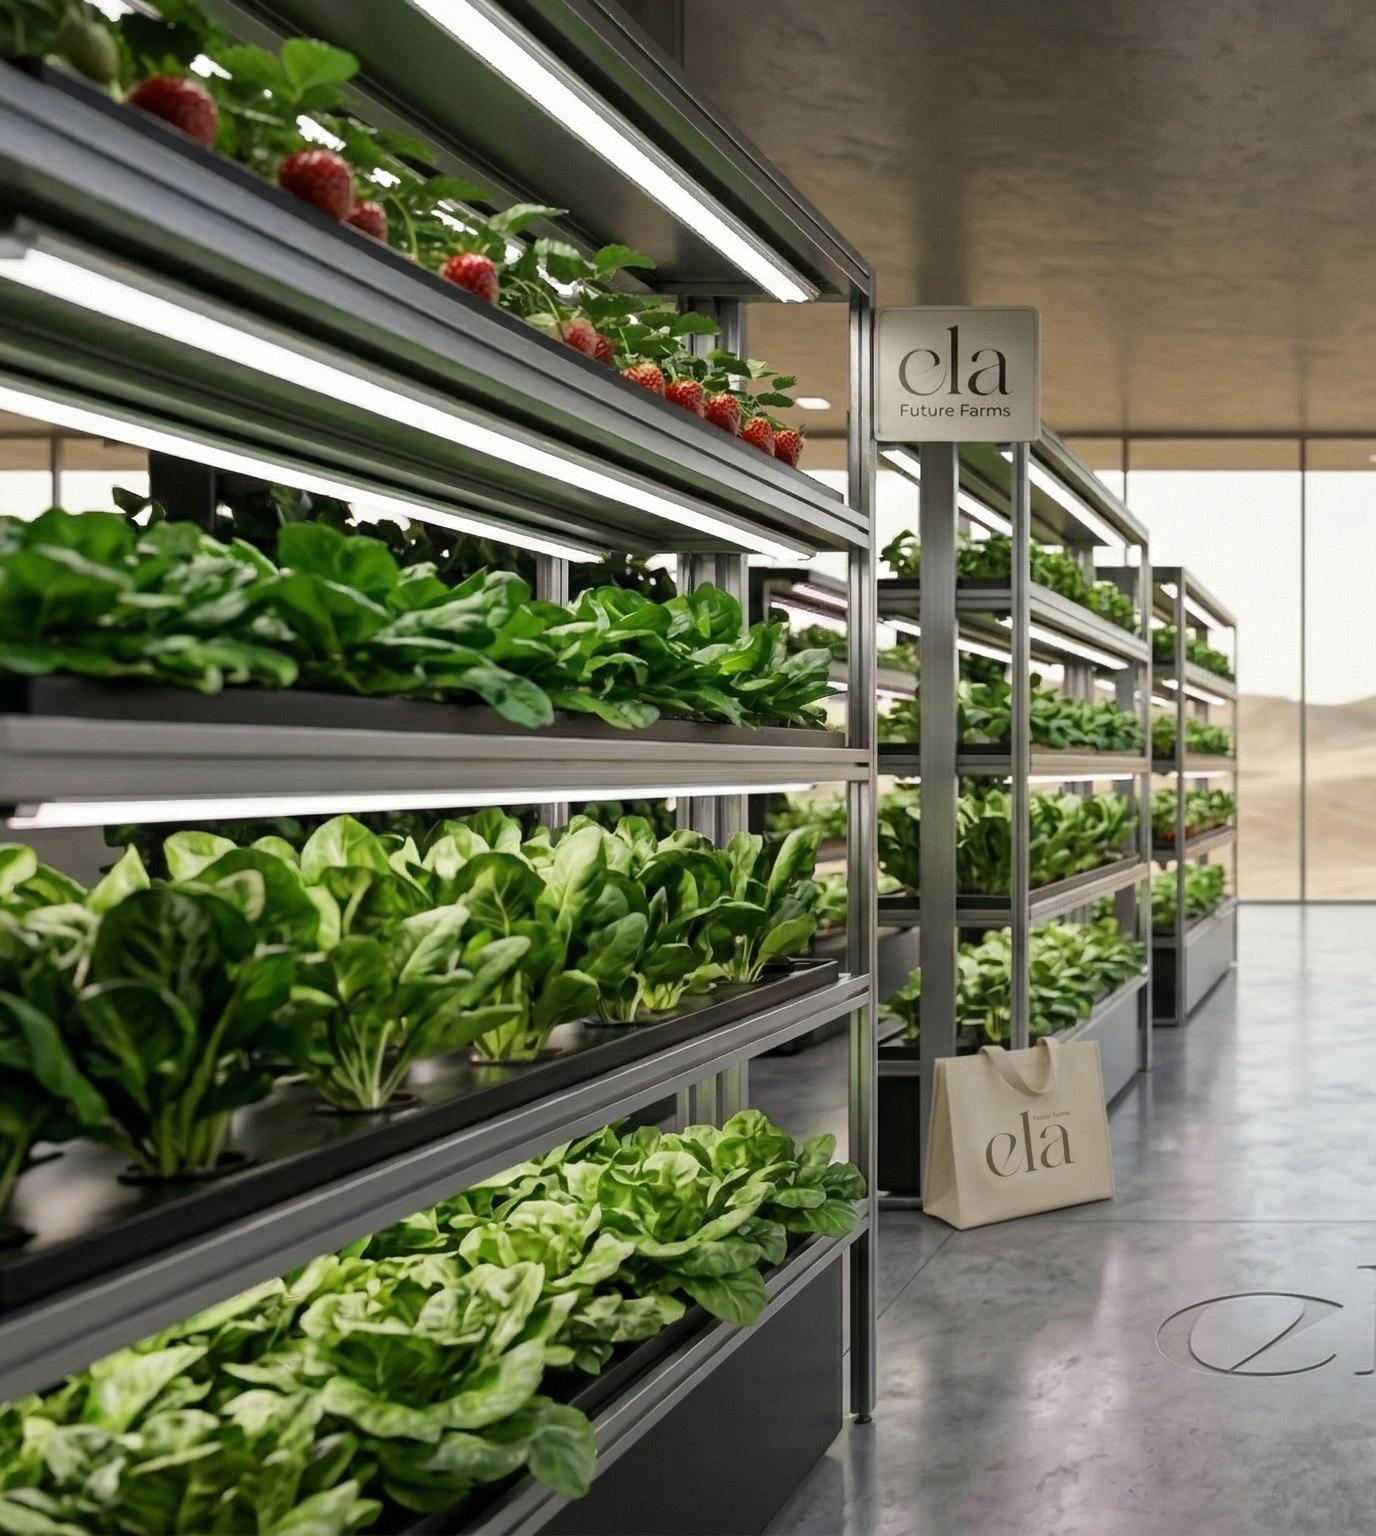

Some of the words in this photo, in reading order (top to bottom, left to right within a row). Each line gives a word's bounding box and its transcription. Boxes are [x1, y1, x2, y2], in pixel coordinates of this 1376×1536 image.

[900, 404, 955, 417] Future
[960, 404, 1011, 417] Farms
[985, 1110, 1076, 1177] ela
